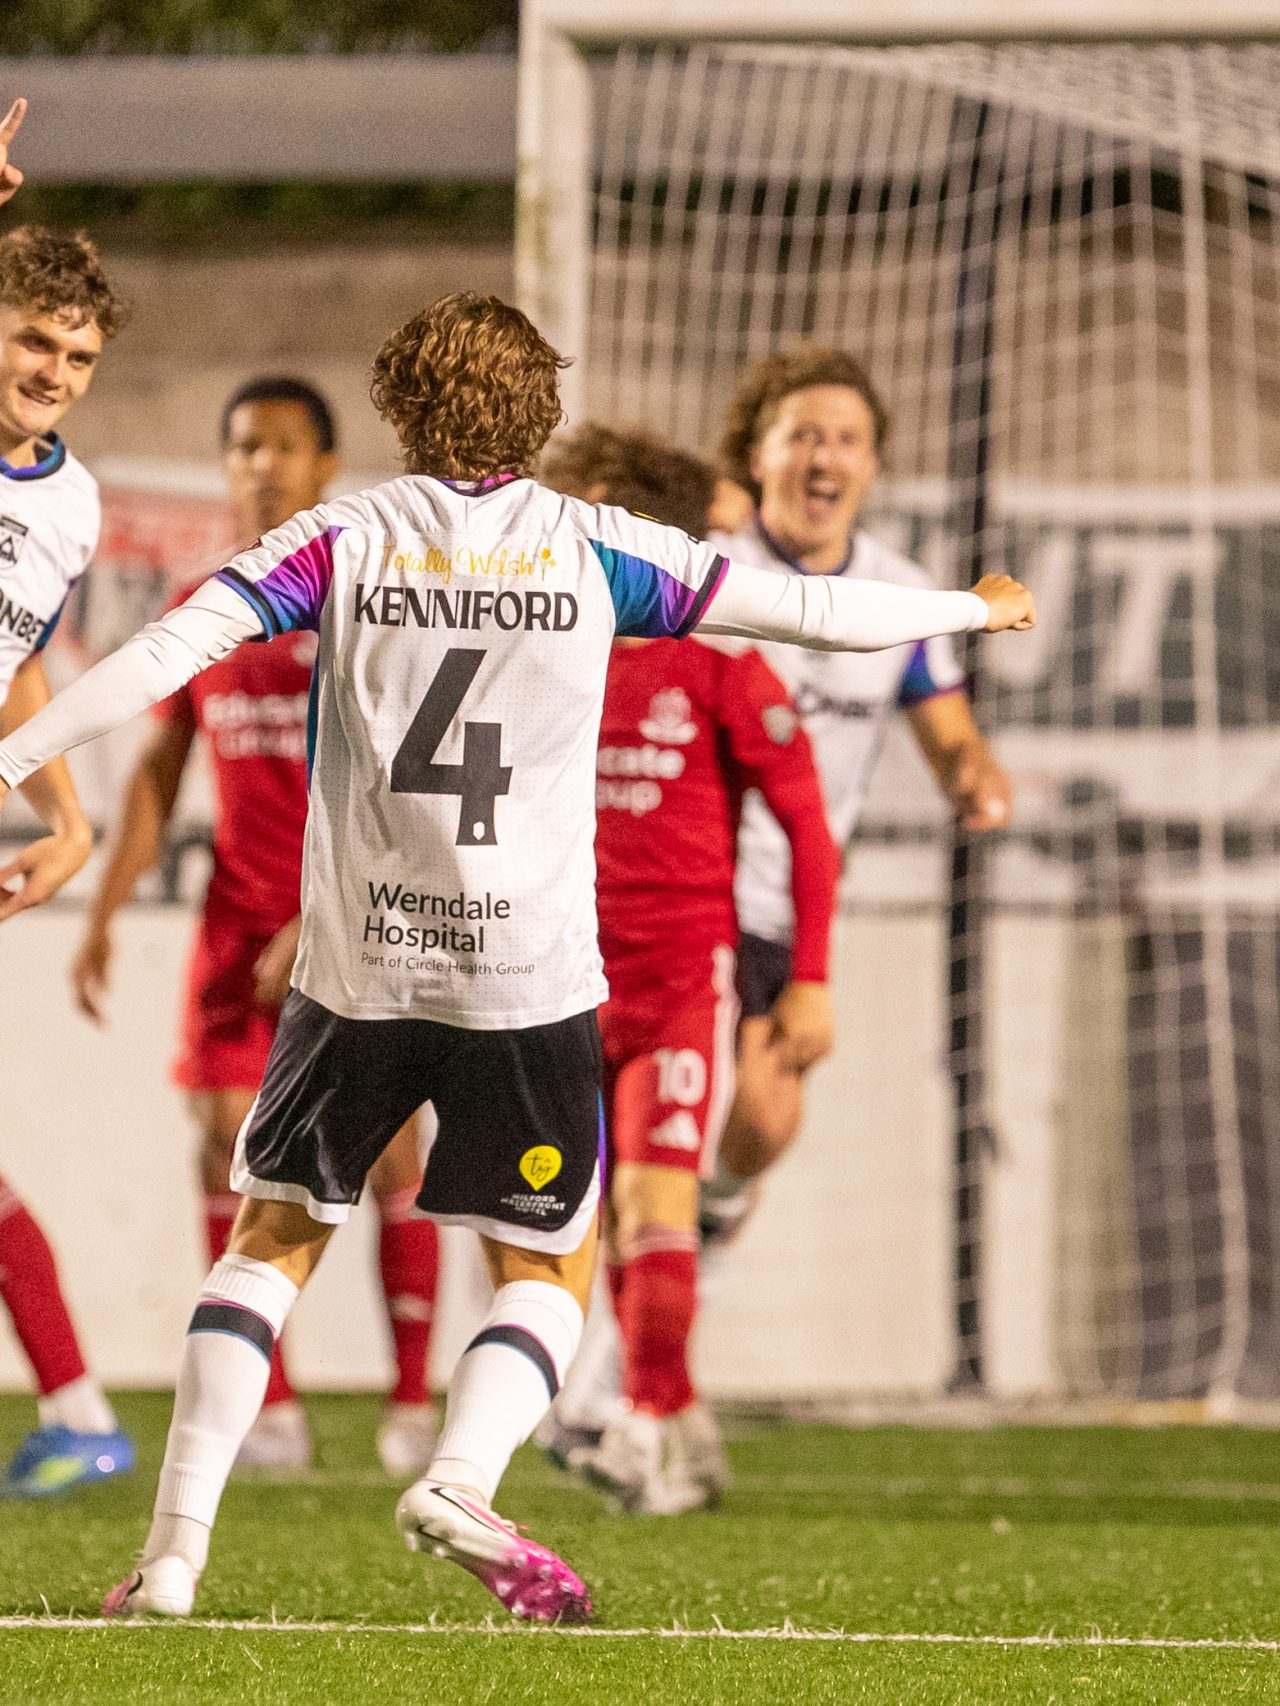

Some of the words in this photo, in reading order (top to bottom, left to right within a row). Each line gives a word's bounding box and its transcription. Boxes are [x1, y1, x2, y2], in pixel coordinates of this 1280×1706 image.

[379, 544, 452, 585] Totally
[455, 546, 534, 577] Welsh
[354, 583, 579, 632] KENNIFORD
[390, 648, 513, 846] 4
[368, 881, 511, 920] Werndale
[363, 915, 485, 954] Hospital
[361, 952, 385, 968] Part
[388, 954, 402, 969] of
[405, 957, 444, 972] Circle
[448, 961, 492, 976] Health
[495, 962, 535, 976] Group
[652, 1047, 708, 1107] 10
